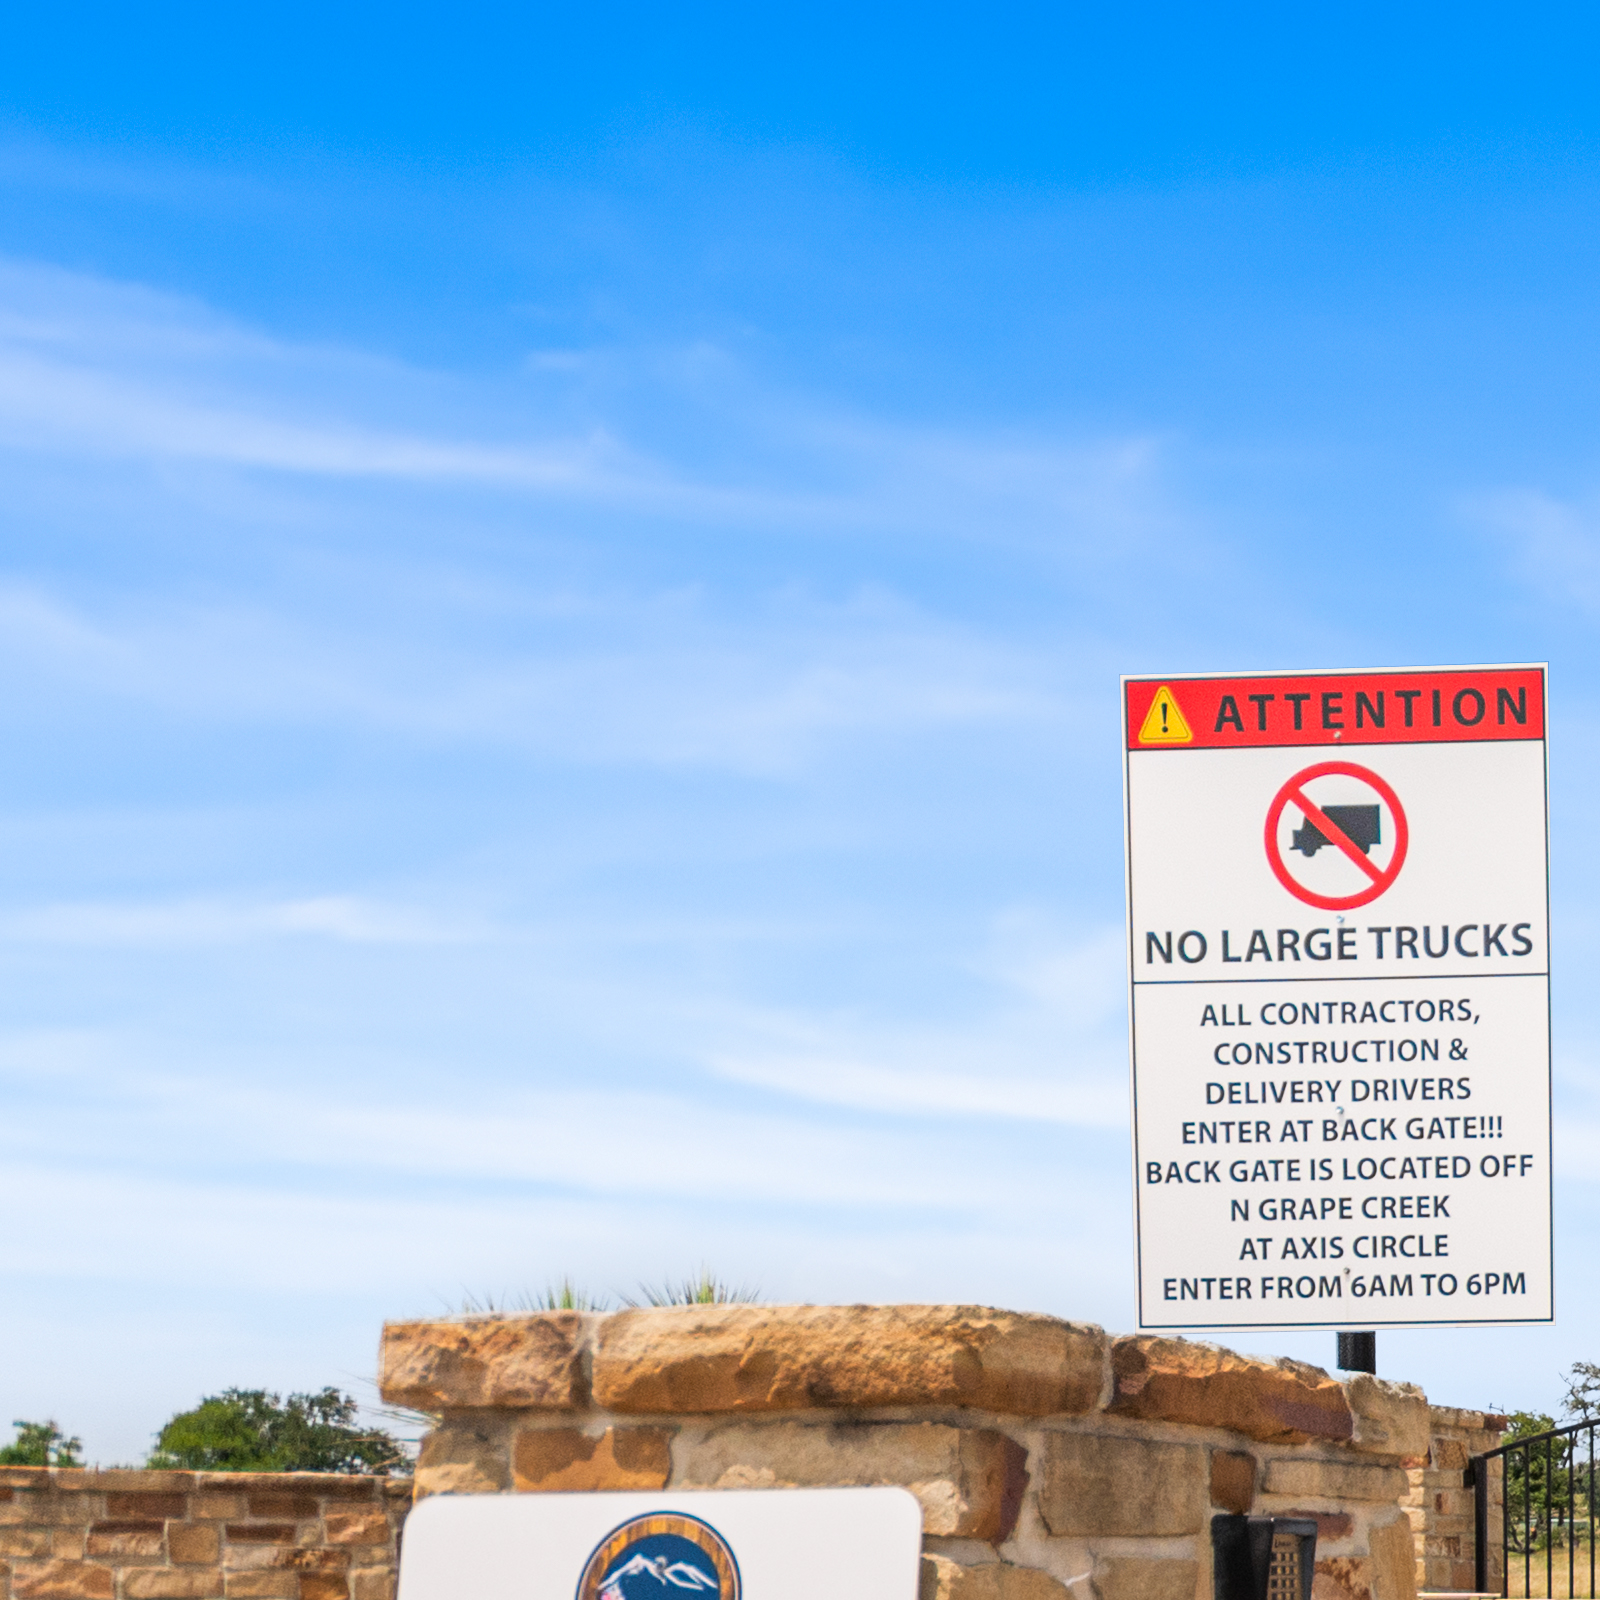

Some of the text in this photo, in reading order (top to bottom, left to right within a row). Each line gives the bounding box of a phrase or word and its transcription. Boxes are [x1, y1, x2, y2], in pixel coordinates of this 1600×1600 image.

[1214, 687, 1526, 732] ATTENTION
[1147, 923, 1532, 964] NO LARGE TRUCKS
[1201, 999, 1479, 1026] ALL CONTRACTORS,
[1214, 1038, 1467, 1065] CONSTRUCTION &
[1206, 1077, 1470, 1104] DELIVERY DRIVERS
[1183, 1116, 1502, 1144] ENTER AT BACK GATE!!!
[1147, 1155, 1533, 1184] BACK GATE IS LOCATED OFF
[1231, 1196, 1449, 1221] N GRAPE CREEK
[1239, 1235, 1448, 1260] AT AXIS CIRCLE
[1164, 1272, 1525, 1300] ENTER FROM 6AM TO 6PM
